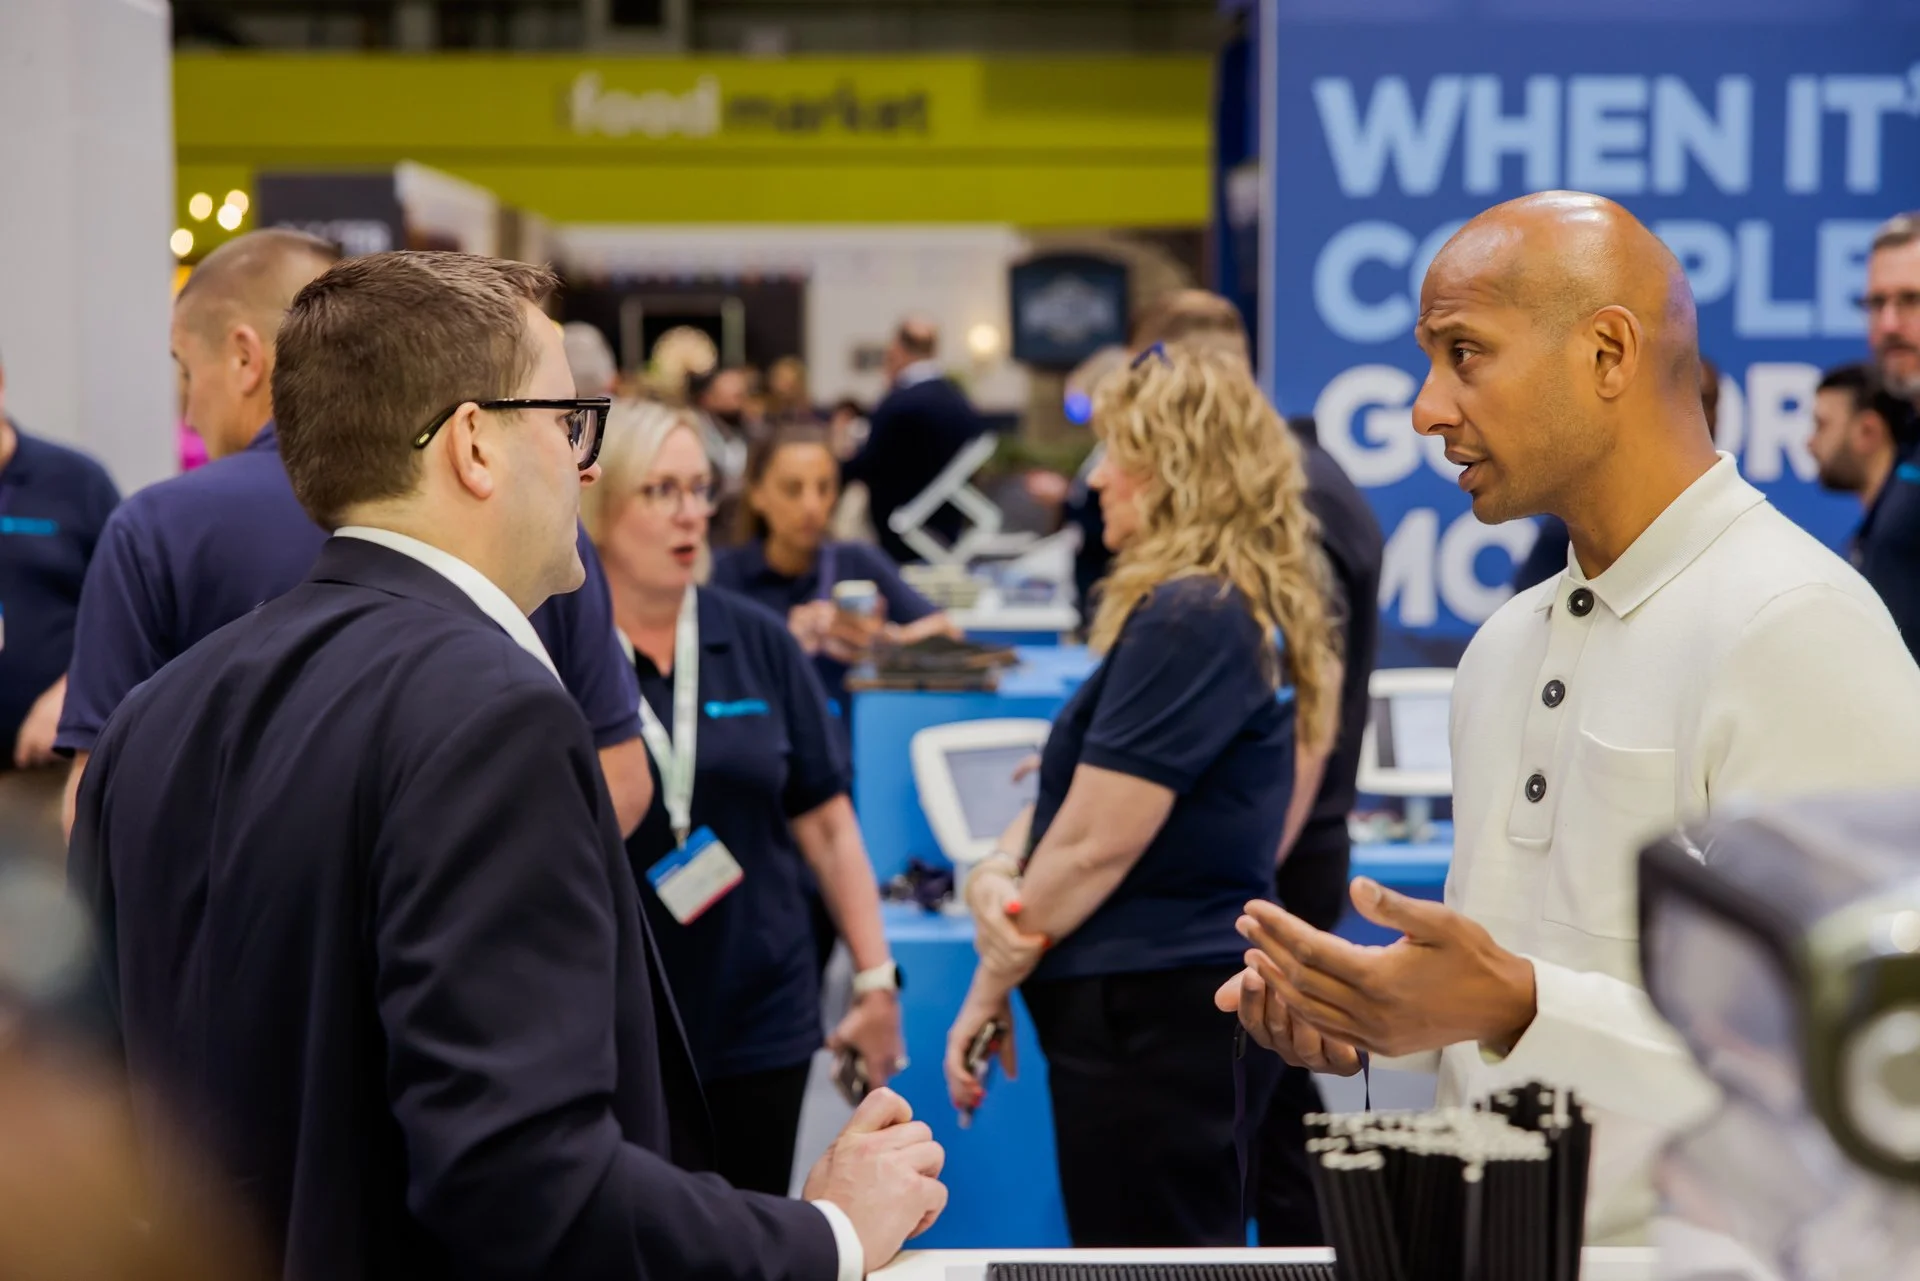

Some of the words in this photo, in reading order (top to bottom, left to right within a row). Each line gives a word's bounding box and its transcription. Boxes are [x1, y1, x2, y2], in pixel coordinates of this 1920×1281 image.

[571, 70, 722, 137] food
[1314, 76, 1751, 194] WHEN
[1313, 219, 1870, 342] CPLE
